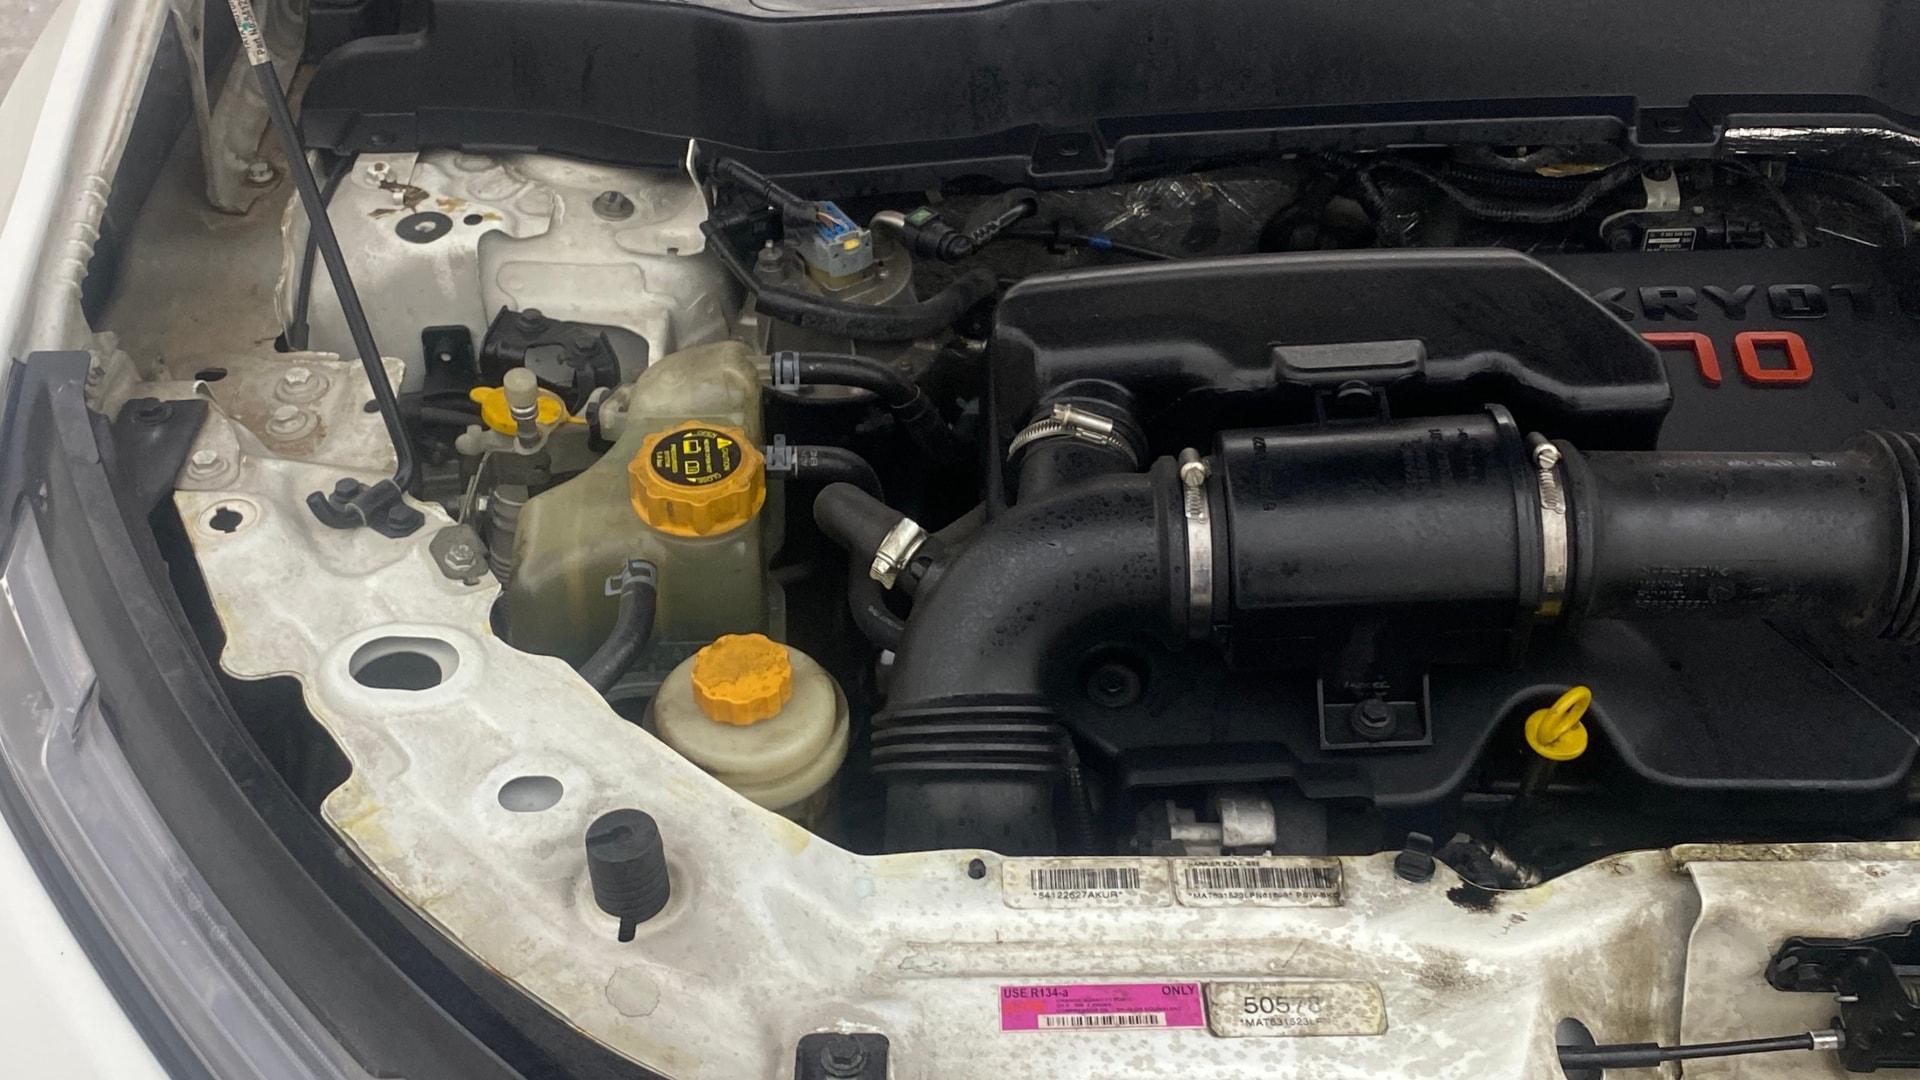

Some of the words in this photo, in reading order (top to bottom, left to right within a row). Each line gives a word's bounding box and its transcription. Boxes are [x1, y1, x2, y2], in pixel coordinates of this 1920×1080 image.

[721, 448, 730, 471] CAUTION
[1004, 988, 1028, 999] USE
[1031, 987, 1069, 998] R134-a
[1161, 985, 1196, 996] ONLY
